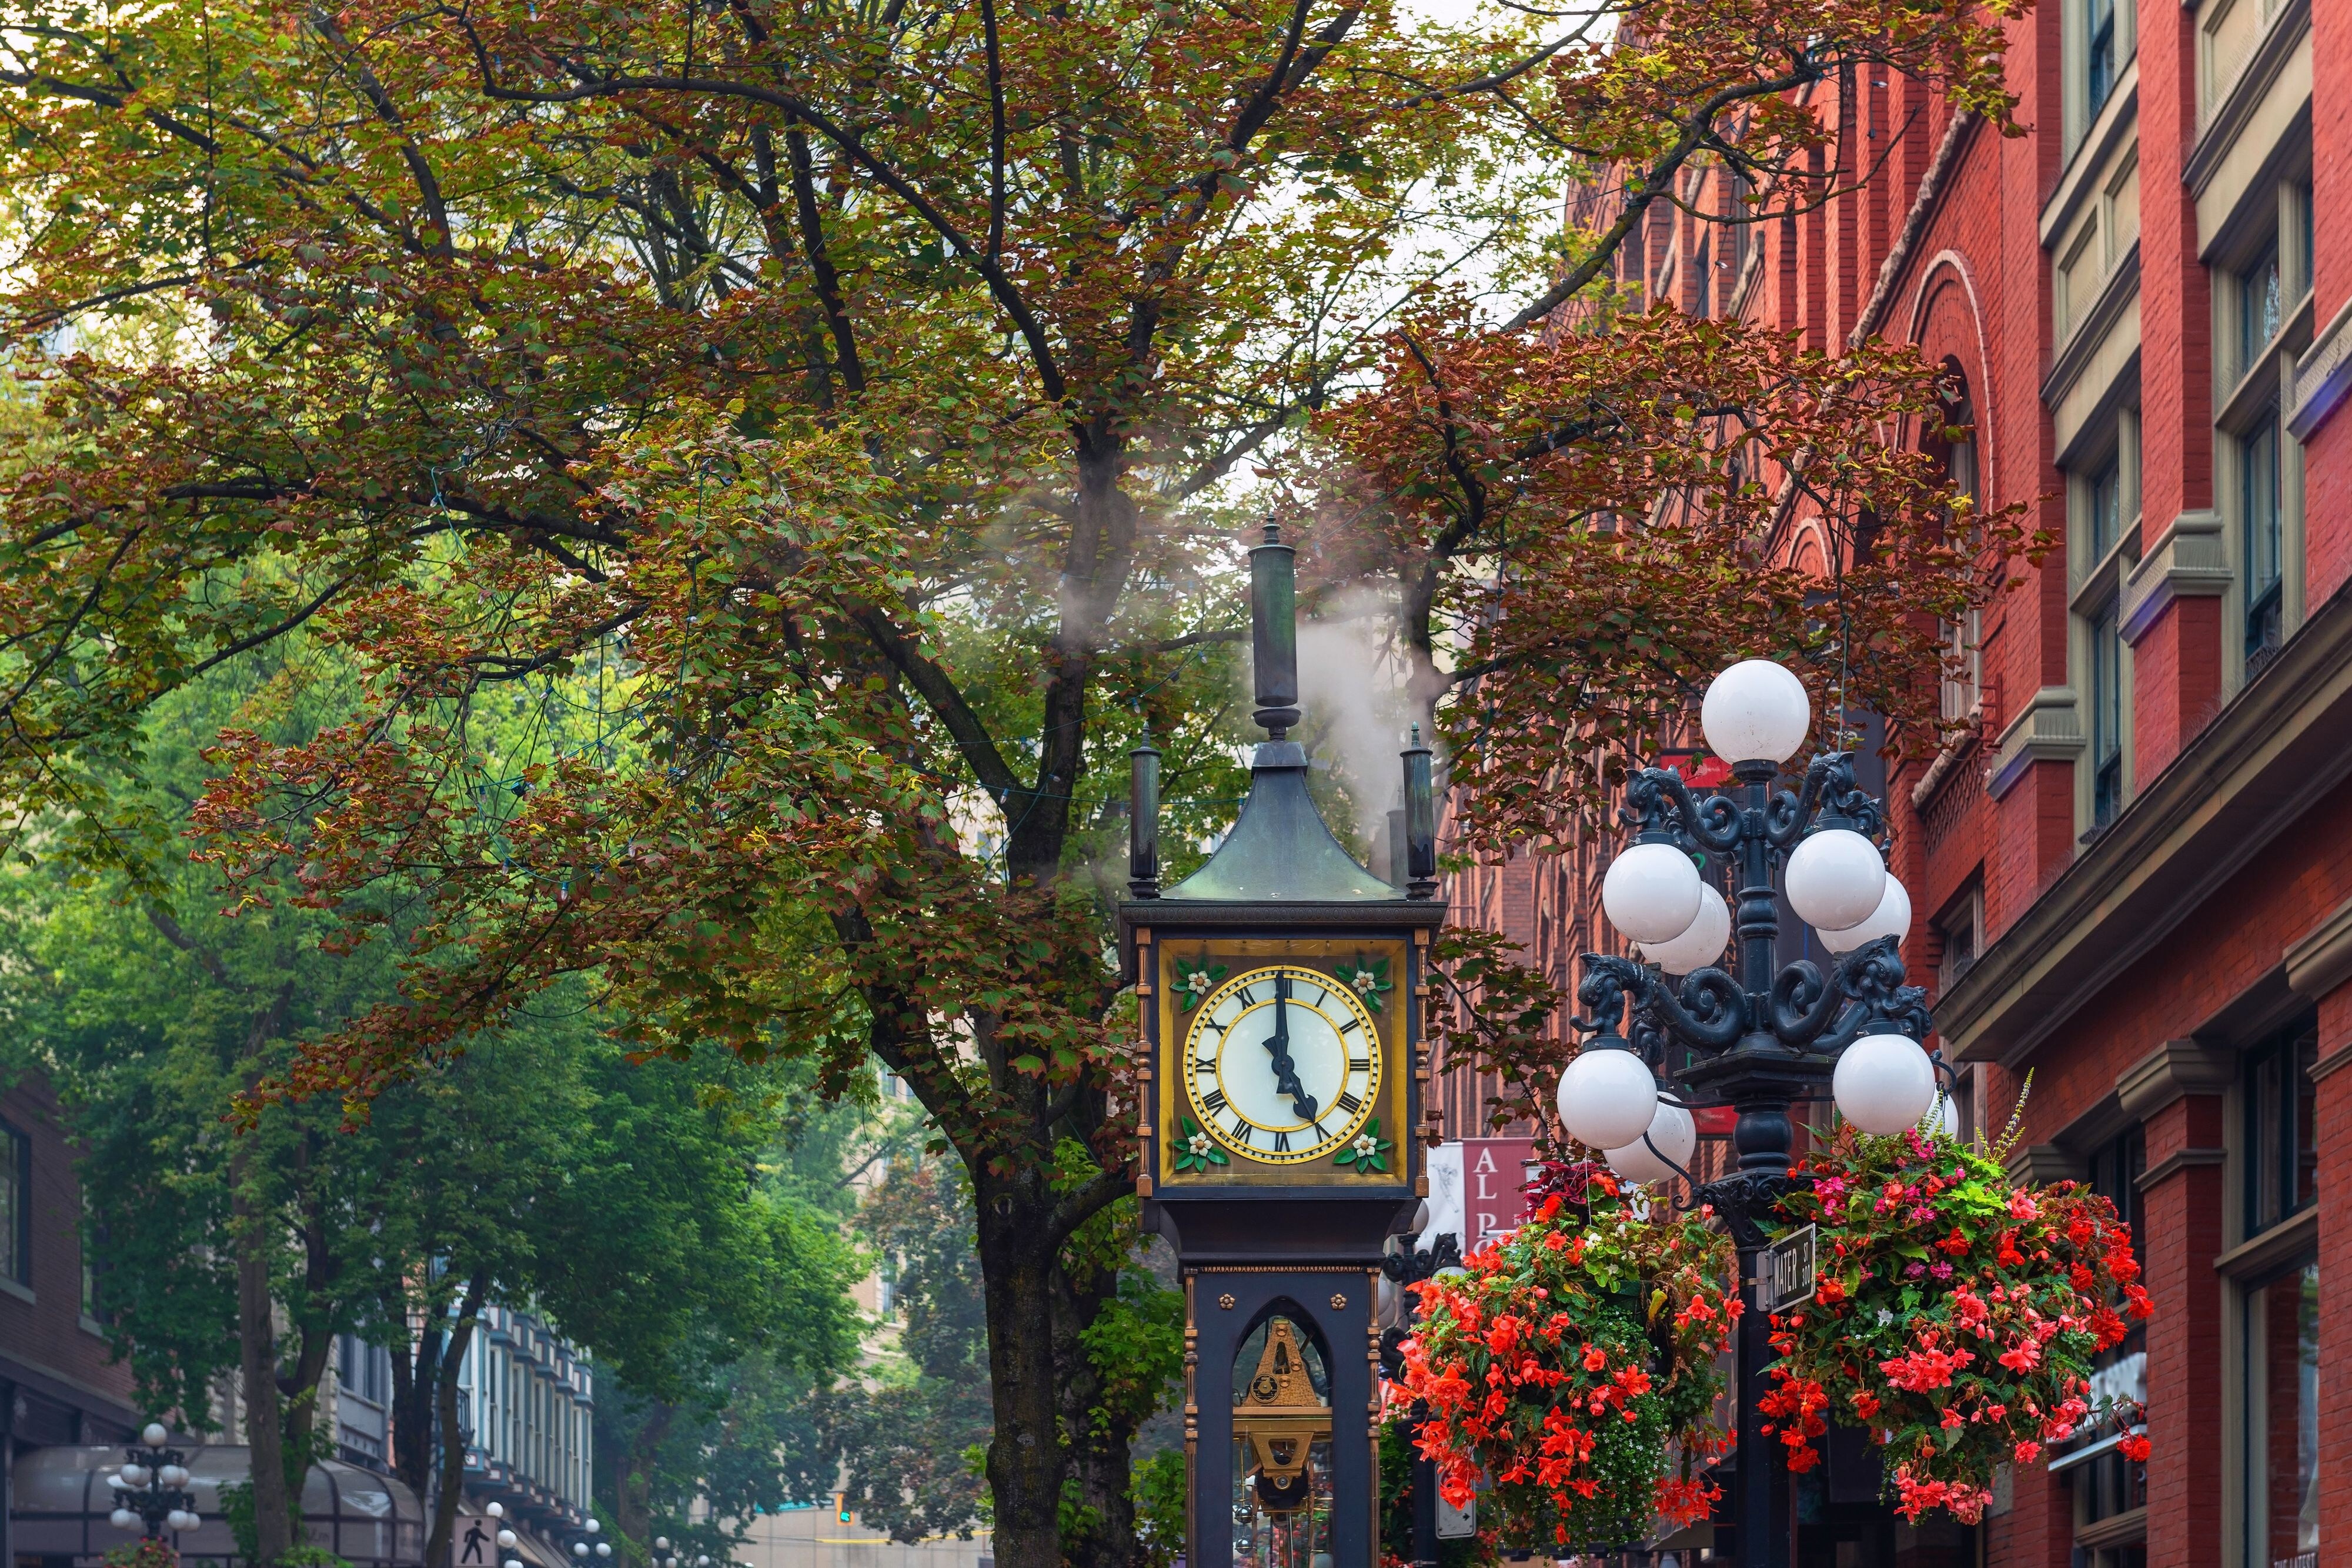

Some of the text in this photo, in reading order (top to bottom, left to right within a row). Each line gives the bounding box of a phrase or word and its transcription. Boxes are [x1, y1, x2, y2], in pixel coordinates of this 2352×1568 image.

[1234, 986, 1257, 1011] XI
[1205, 1017, 1228, 1037] X
[1340, 1018, 1361, 1035] II
[1195, 1057, 1217, 1074] IX
[1349, 1058, 1369, 1071] III
[1202, 1088, 1228, 1118] VIII
[1231, 1118, 1258, 1145] VII
[1275, 1131, 1291, 1152] VI
[1315, 1122, 1332, 1143] V
[1774, 1242, 1808, 1298] WATER ST
[1802, 1264, 1810, 1287] 300
